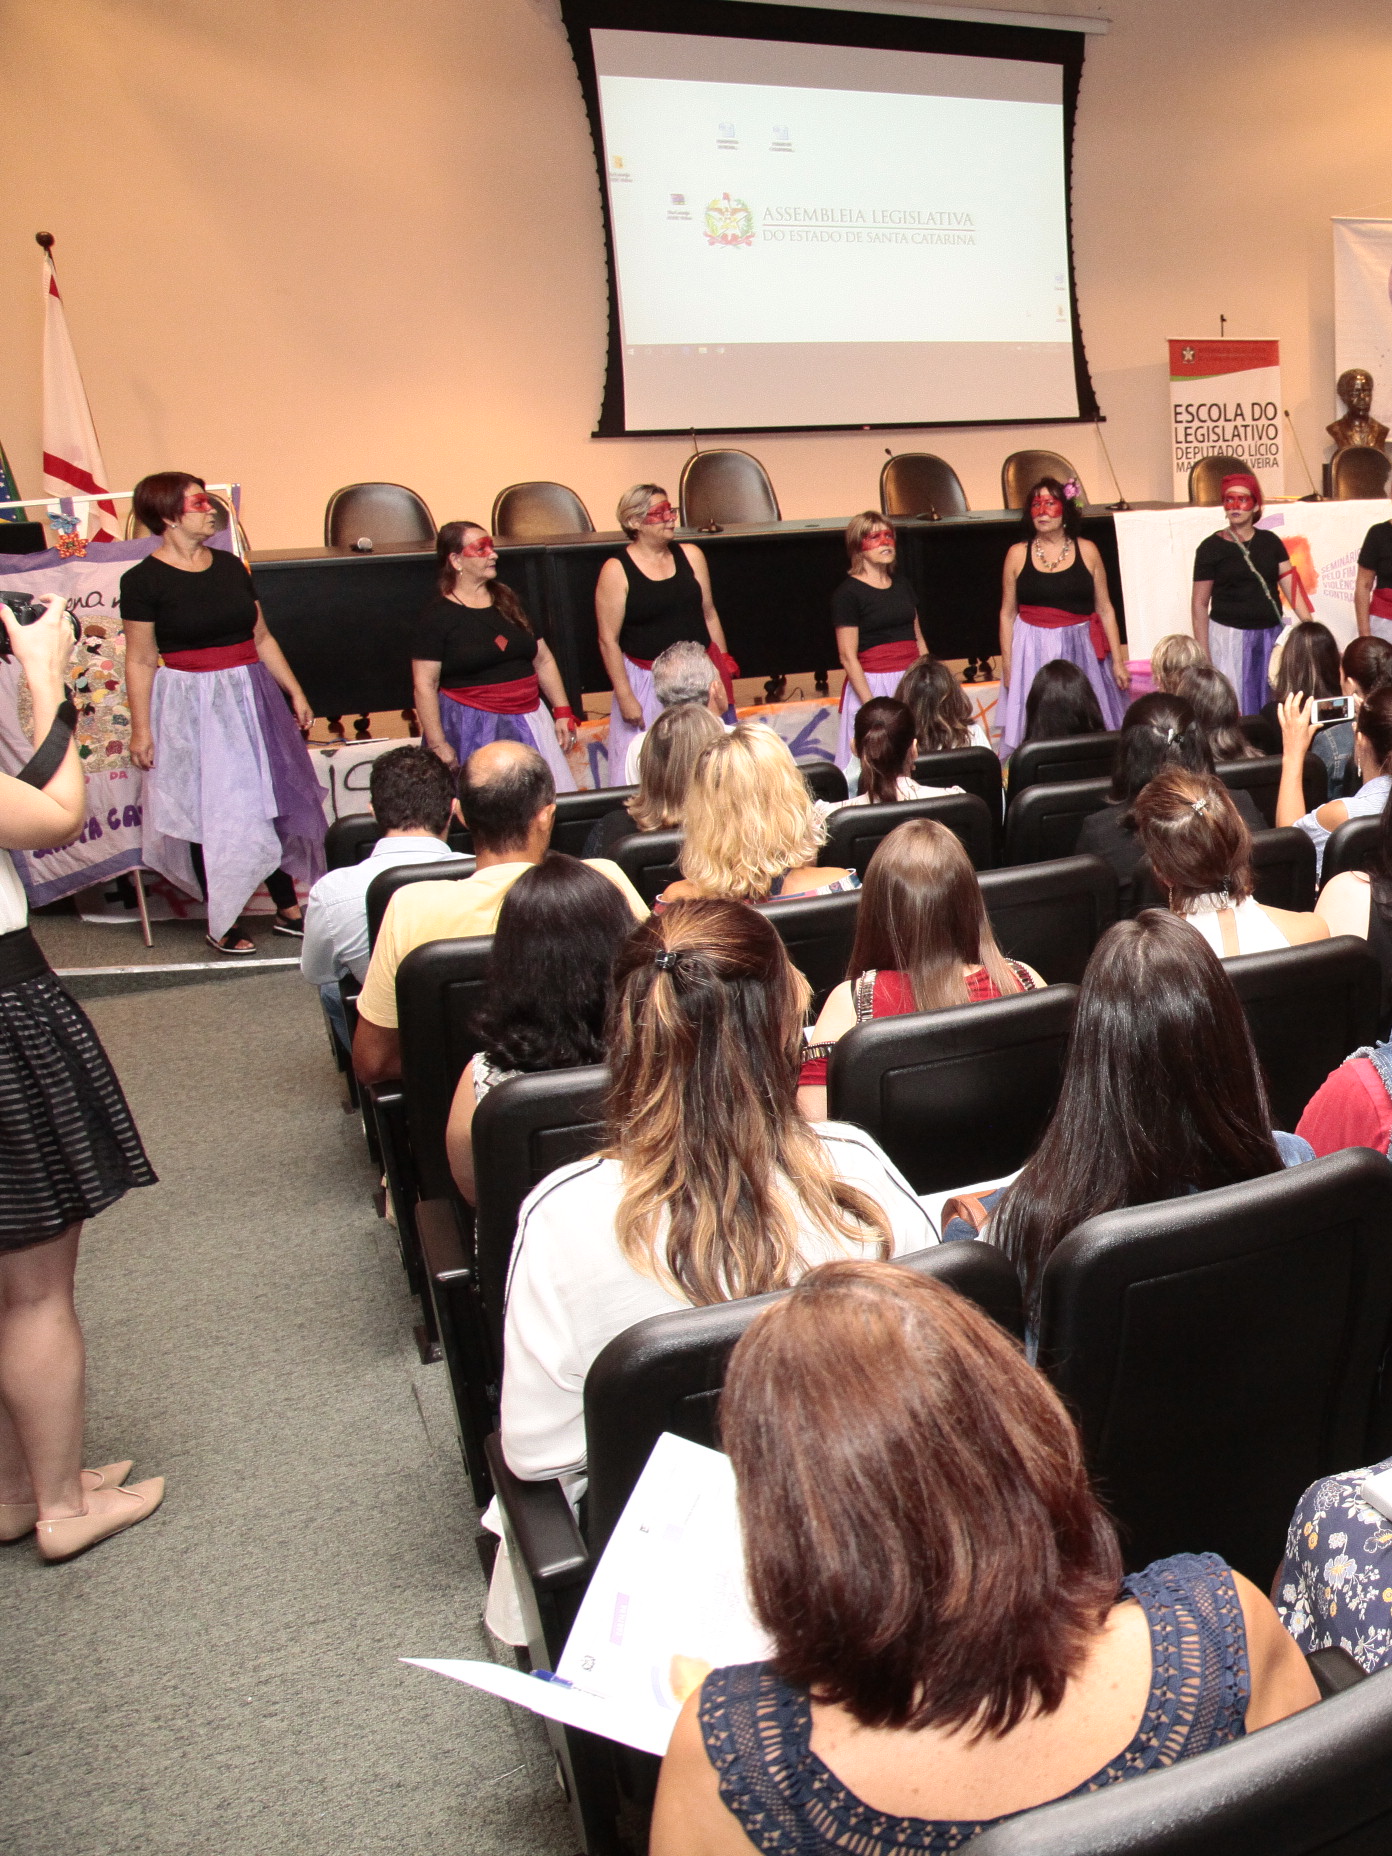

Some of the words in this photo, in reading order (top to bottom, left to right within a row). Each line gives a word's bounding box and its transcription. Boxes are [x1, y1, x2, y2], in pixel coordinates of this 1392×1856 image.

[762, 206, 866, 223] ASSEMBLEIA
[872, 209, 975, 226] LEGISLATIVA
[763, 229, 785, 242] DO
[789, 230, 842, 243] ESTADO
[846, 231, 863, 243] DE
[866, 231, 909, 244] SANTA
[911, 232, 976, 246] CATARINA
[1174, 403, 1246, 424] ESCOLA
[1251, 401, 1278, 422] DO
[1174, 423, 1278, 444] LEGISLATIVO
[1175, 444, 1245, 460] DEPUTADO
[1248, 441, 1279, 457] LÍCIO
[1322, 570, 1341, 580] PELO
[1343, 566, 1356, 578] FIM
[1323, 579, 1355, 590] VIOLÊNC
[109, 770, 128, 780] DA
